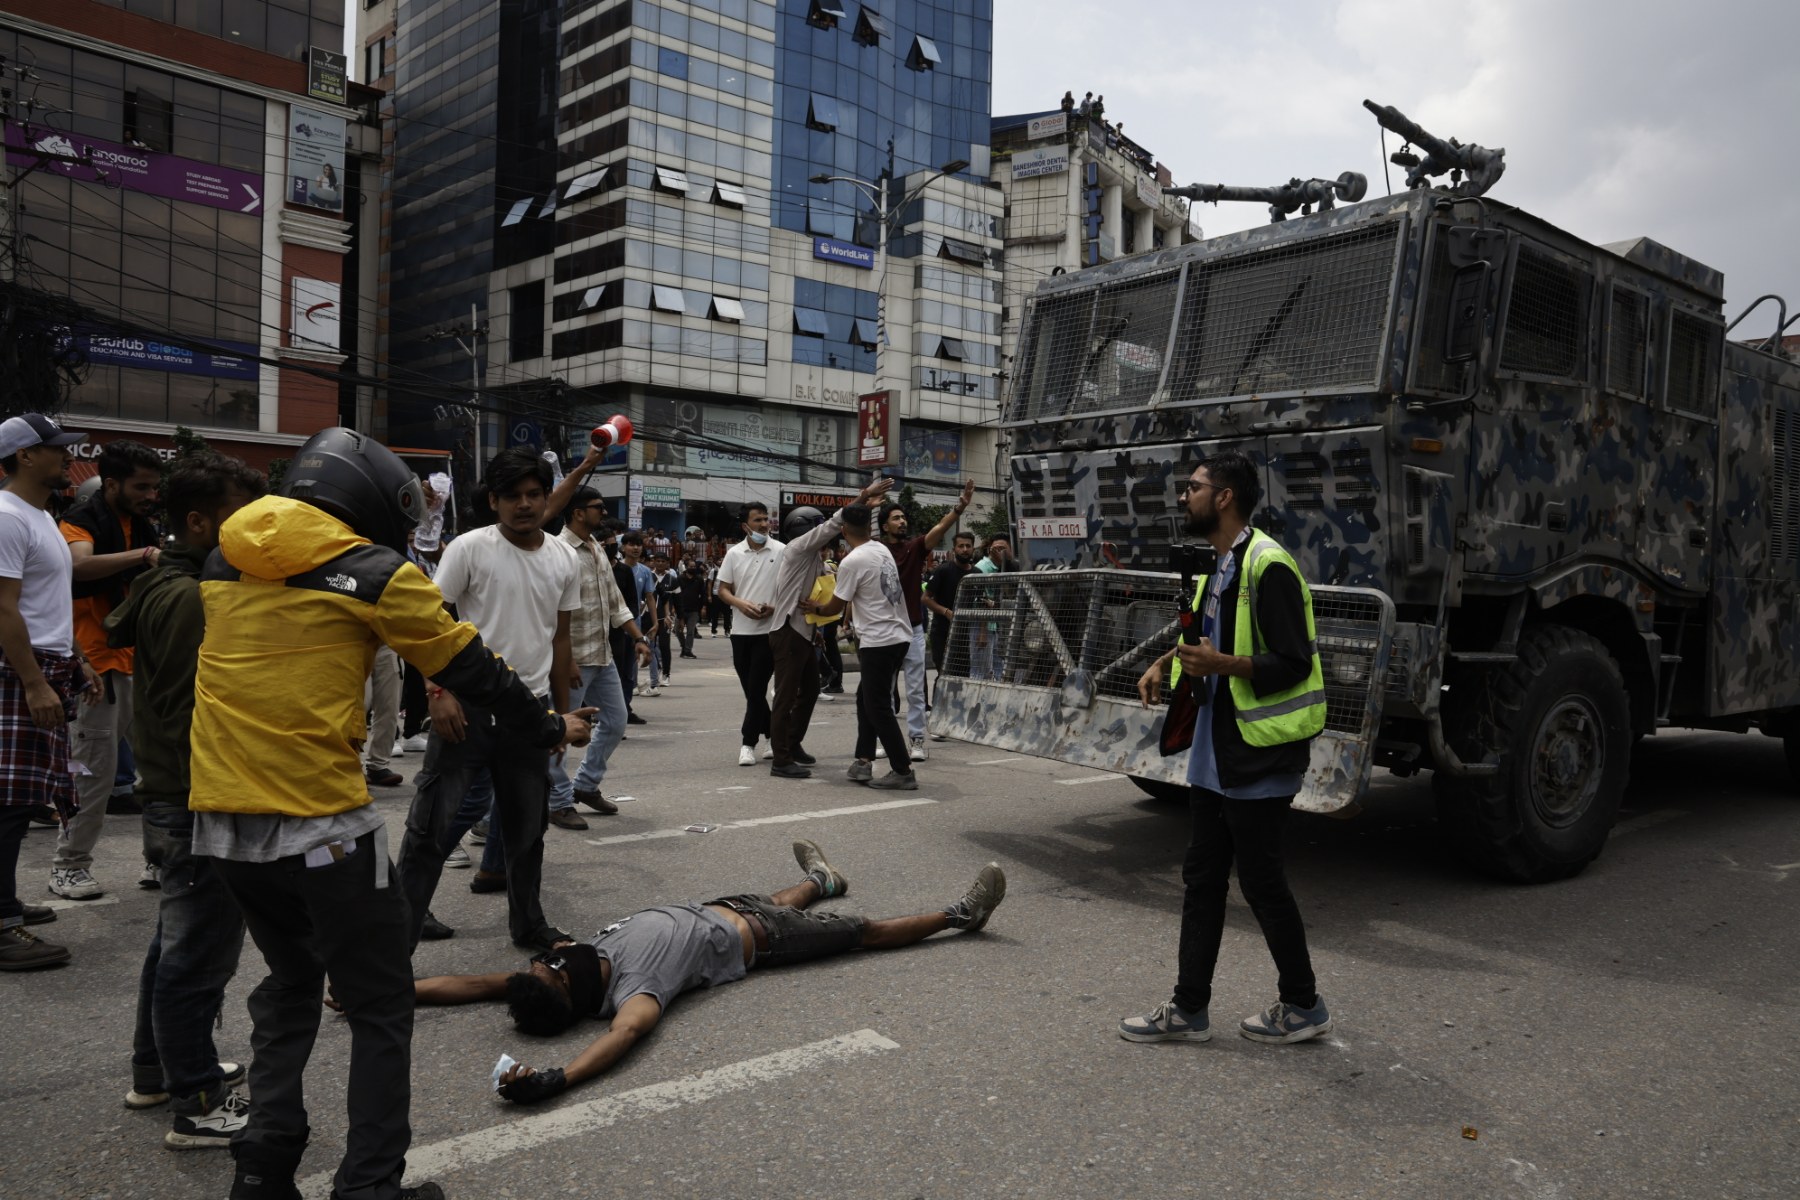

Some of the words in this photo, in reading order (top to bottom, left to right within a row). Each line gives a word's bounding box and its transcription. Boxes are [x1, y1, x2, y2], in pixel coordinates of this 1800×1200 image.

[1012, 159, 1046, 172] BANESHWOR
[1046, 156, 1068, 165] DENTAL
[1017, 167, 1041, 178] IMAGING
[1041, 164, 1063, 174] CENTER
[186, 171, 201, 181] STUDY
[202, 174, 222, 184] ABROAD
[186, 179, 198, 187] TEST
[198, 181, 230, 193] PREPARATION
[186, 186, 207, 196] SUPPORT
[207, 190, 229, 200] SERVICES
[831, 245, 870, 261] WorldLink
[90, 346, 130, 358] EDUCATION
[131, 350, 146, 359] AND
[147, 352, 163, 361] VISA
[163, 354, 193, 364] SERVICES
[739, 423, 760, 439] EYE
[762, 426, 801, 443] CENTER
[795, 493, 836, 507] KOLKATA
[1032, 525, 1039, 536] K
[1042, 524, 1053, 536] AA
[1058, 524, 1081, 537] 0101
[325, 576, 347, 586] NORTH
[329, 581, 349, 591] FACE
